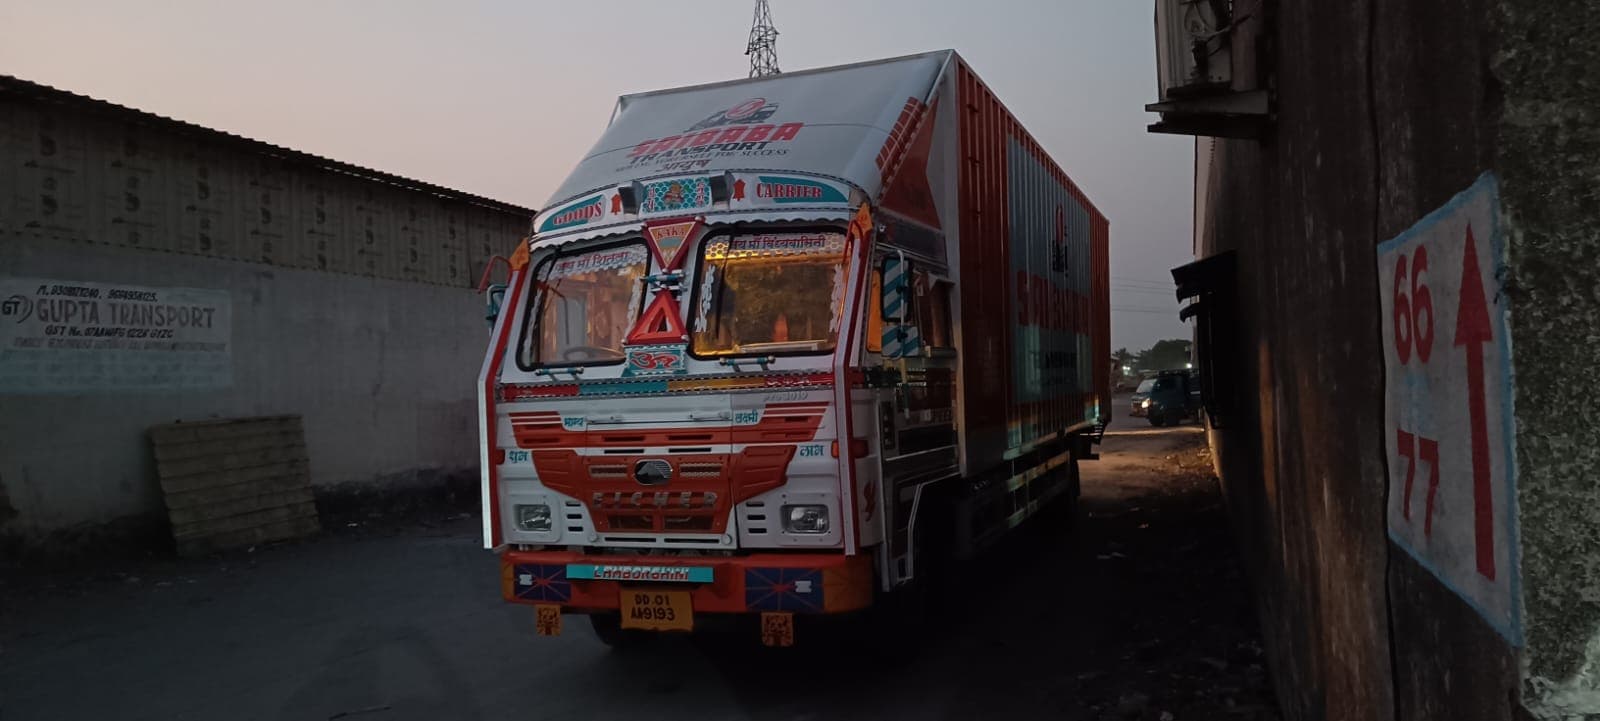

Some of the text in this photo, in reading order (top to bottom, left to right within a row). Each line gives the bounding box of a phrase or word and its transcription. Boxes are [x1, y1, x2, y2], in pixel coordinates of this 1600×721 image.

[626, 122, 804, 158] SAIBABA
[630, 141, 769, 164] TRANSPORT
[756, 182, 824, 199] CARRIER
[553, 201, 603, 225] GOODS
[36, 298, 216, 328] GUPTA TRANSPORT
[1393, 245, 1434, 365] 66
[45, 325, 67, 337] GST
[1397, 430, 1439, 537] 77
[592, 490, 718, 509] EICHER
